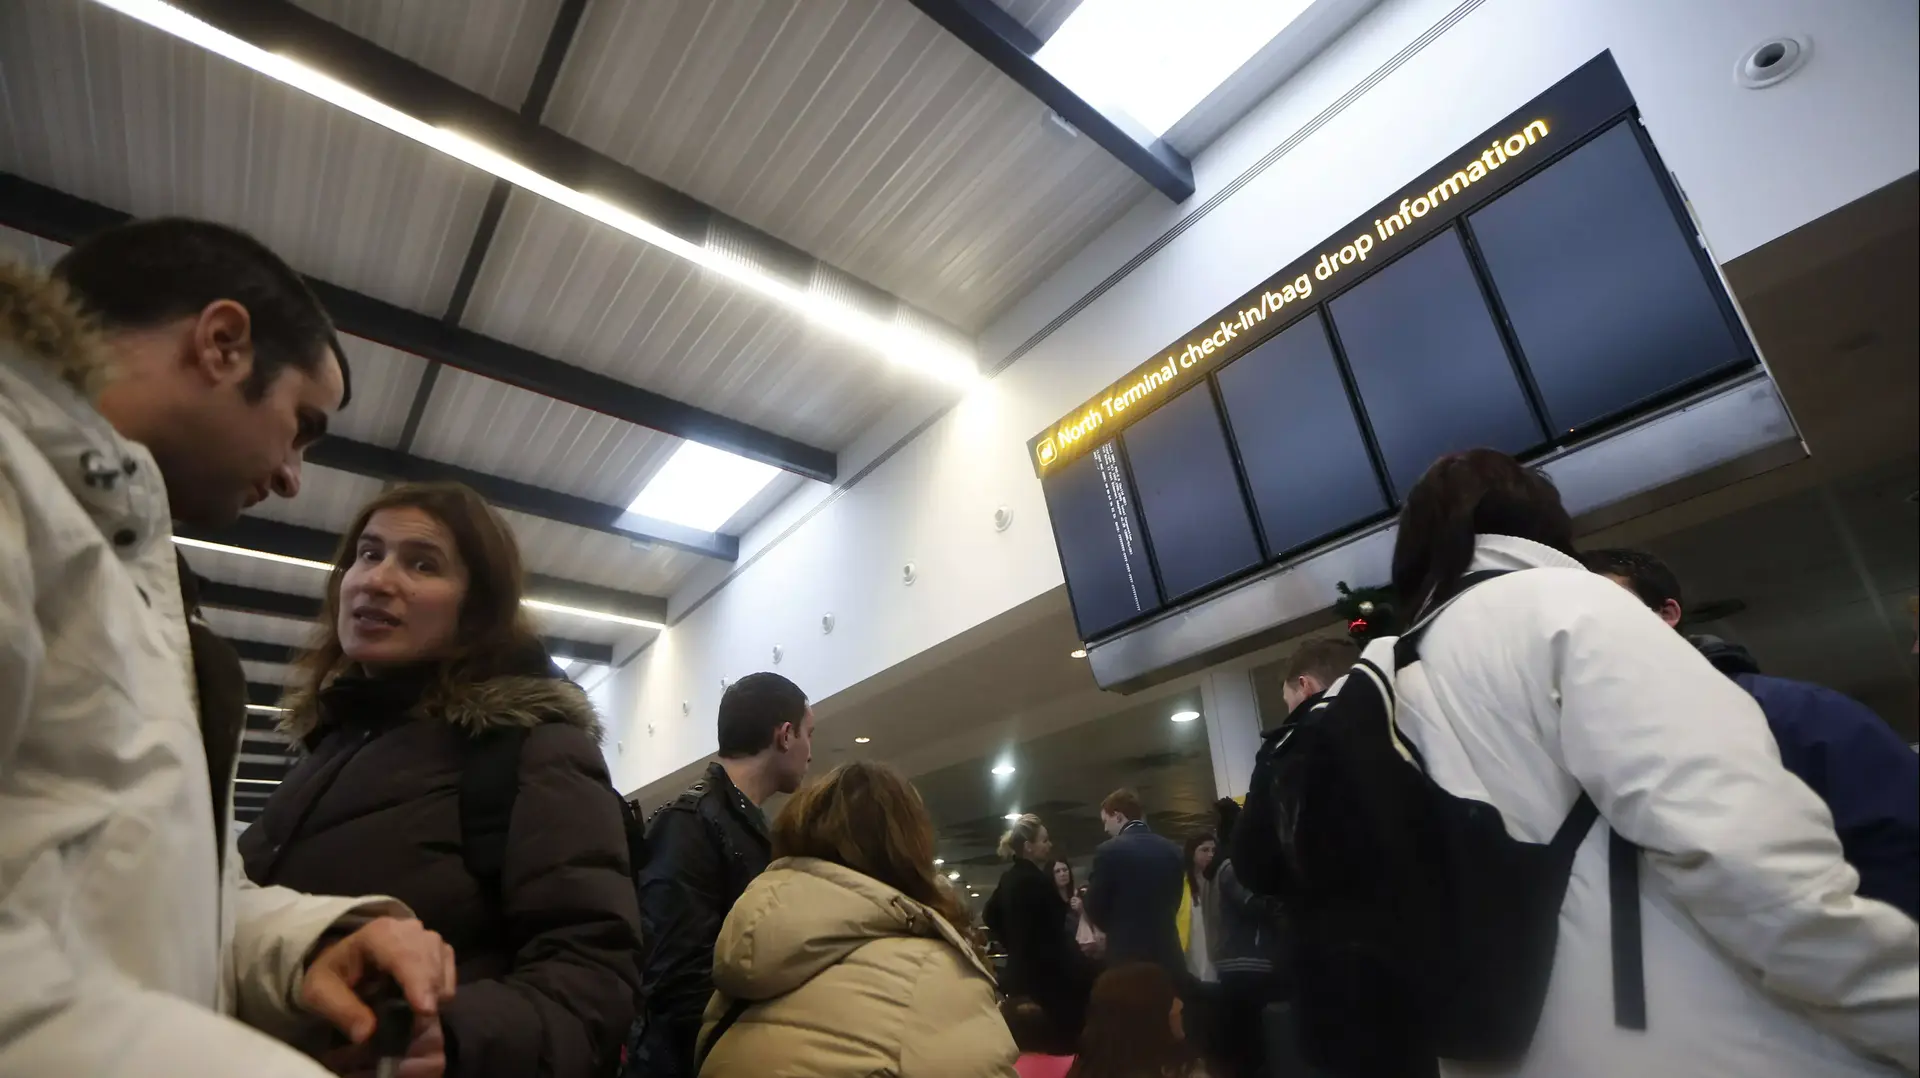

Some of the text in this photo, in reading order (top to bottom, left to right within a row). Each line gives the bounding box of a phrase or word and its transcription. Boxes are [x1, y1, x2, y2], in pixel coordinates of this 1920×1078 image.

[1057, 118, 1549, 449] North Terminal check-in/bag drop information
